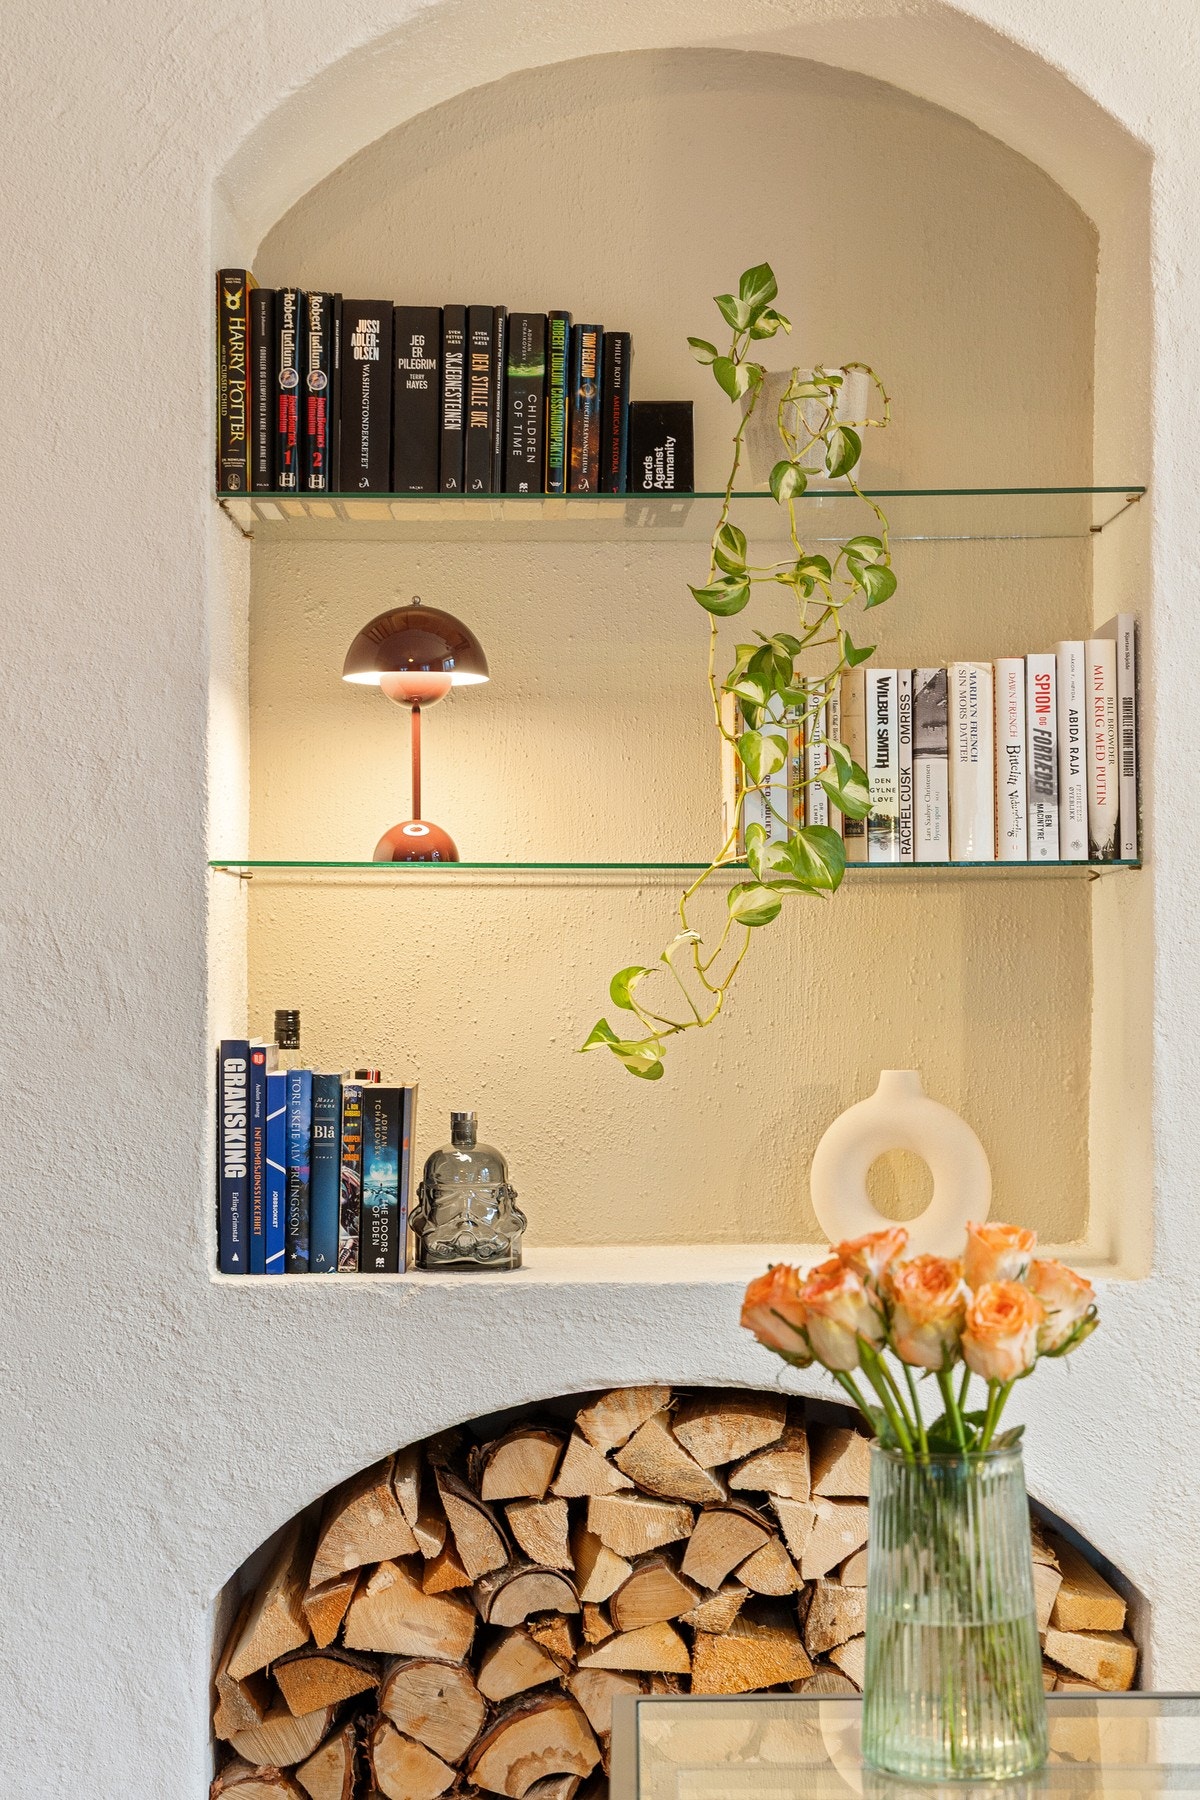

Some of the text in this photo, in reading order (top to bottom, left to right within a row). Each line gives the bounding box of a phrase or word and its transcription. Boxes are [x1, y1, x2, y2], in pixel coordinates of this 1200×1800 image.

[229, 316, 245, 372] HARRY
[282, 293, 296, 367] Robert Ludlum
[309, 295, 324, 369] Robert Ludlum
[350, 333, 380, 347] ADLER-
[356, 320, 380, 334] JUSSI
[409, 335, 425, 346] JEG
[412, 346, 423, 358] ER
[614, 339, 622, 364] PHILIP
[353, 346, 379, 361] OLSEN
[398, 358, 437, 370] PILEGRIM
[581, 332, 596, 378] TOM EGELAND
[406, 380, 428, 390] HAYES
[444, 352, 463, 430] SKJEBNESTEINEN
[470, 353, 489, 428] DEN STILLE UKE
[550, 320, 566, 468] ROBERT LUDLUM CASSANDRAPAKTEN
[228, 380, 246, 444] POTTER
[288, 395, 297, 446] Jason Bournes
[316, 397, 327, 448] Jason Bournes
[360, 364, 370, 469] WASHINGTONDEKRETET
[512, 400, 523, 456] OF TIME
[526, 394, 537, 463] CHILDREN
[612, 395, 620, 435] AMERICAN
[284, 450, 292, 465] 1
[313, 452, 323, 467] 2
[582, 432, 590, 474] EVANGELIUM
[643, 455, 653, 489] Cards
[654, 447, 666, 489] Against
[664, 435, 677, 489] Humanity
[872, 676, 892, 769] WILBUR SMITH
[958, 669, 968, 763] SIN MORS DATTER
[969, 670, 978, 763] MARILYN FRENCH
[1007, 672, 1018, 738] DAWN FRENCH
[1107, 696, 1115, 765] BILL BROWDER
[1122, 696, 1133, 727] SMAKFULLE
[1032, 674, 1054, 796] SPION OG FORRÆDER
[1068, 708, 1080, 776] ABIDA RAJA
[1093, 664, 1107, 806] MIN KRIG MED PUTIN
[900, 694, 912, 855] RACHEL CUSK OMRISS
[1005, 744, 1022, 786] Bittelitt
[1123, 750, 1134, 777] MIDDAGER
[925, 804, 933, 826] Saabye
[1036, 803, 1045, 840] MACINTYRE
[1044, 814, 1052, 828] BEN
[224, 1058, 246, 1178] GRANSKING
[314, 1125, 335, 1138] Blå
[374, 1099, 382, 1161] TCHAIKOVSKY
[253, 1126, 262, 1236] INFORMASJONSSIKKERHET
[290, 1076, 301, 1236] TORE SKEIE ALV ERLINGSSON
[231, 1192, 240, 1242] Erling Grimstad
[372, 1205, 380, 1246] OF EDEN
